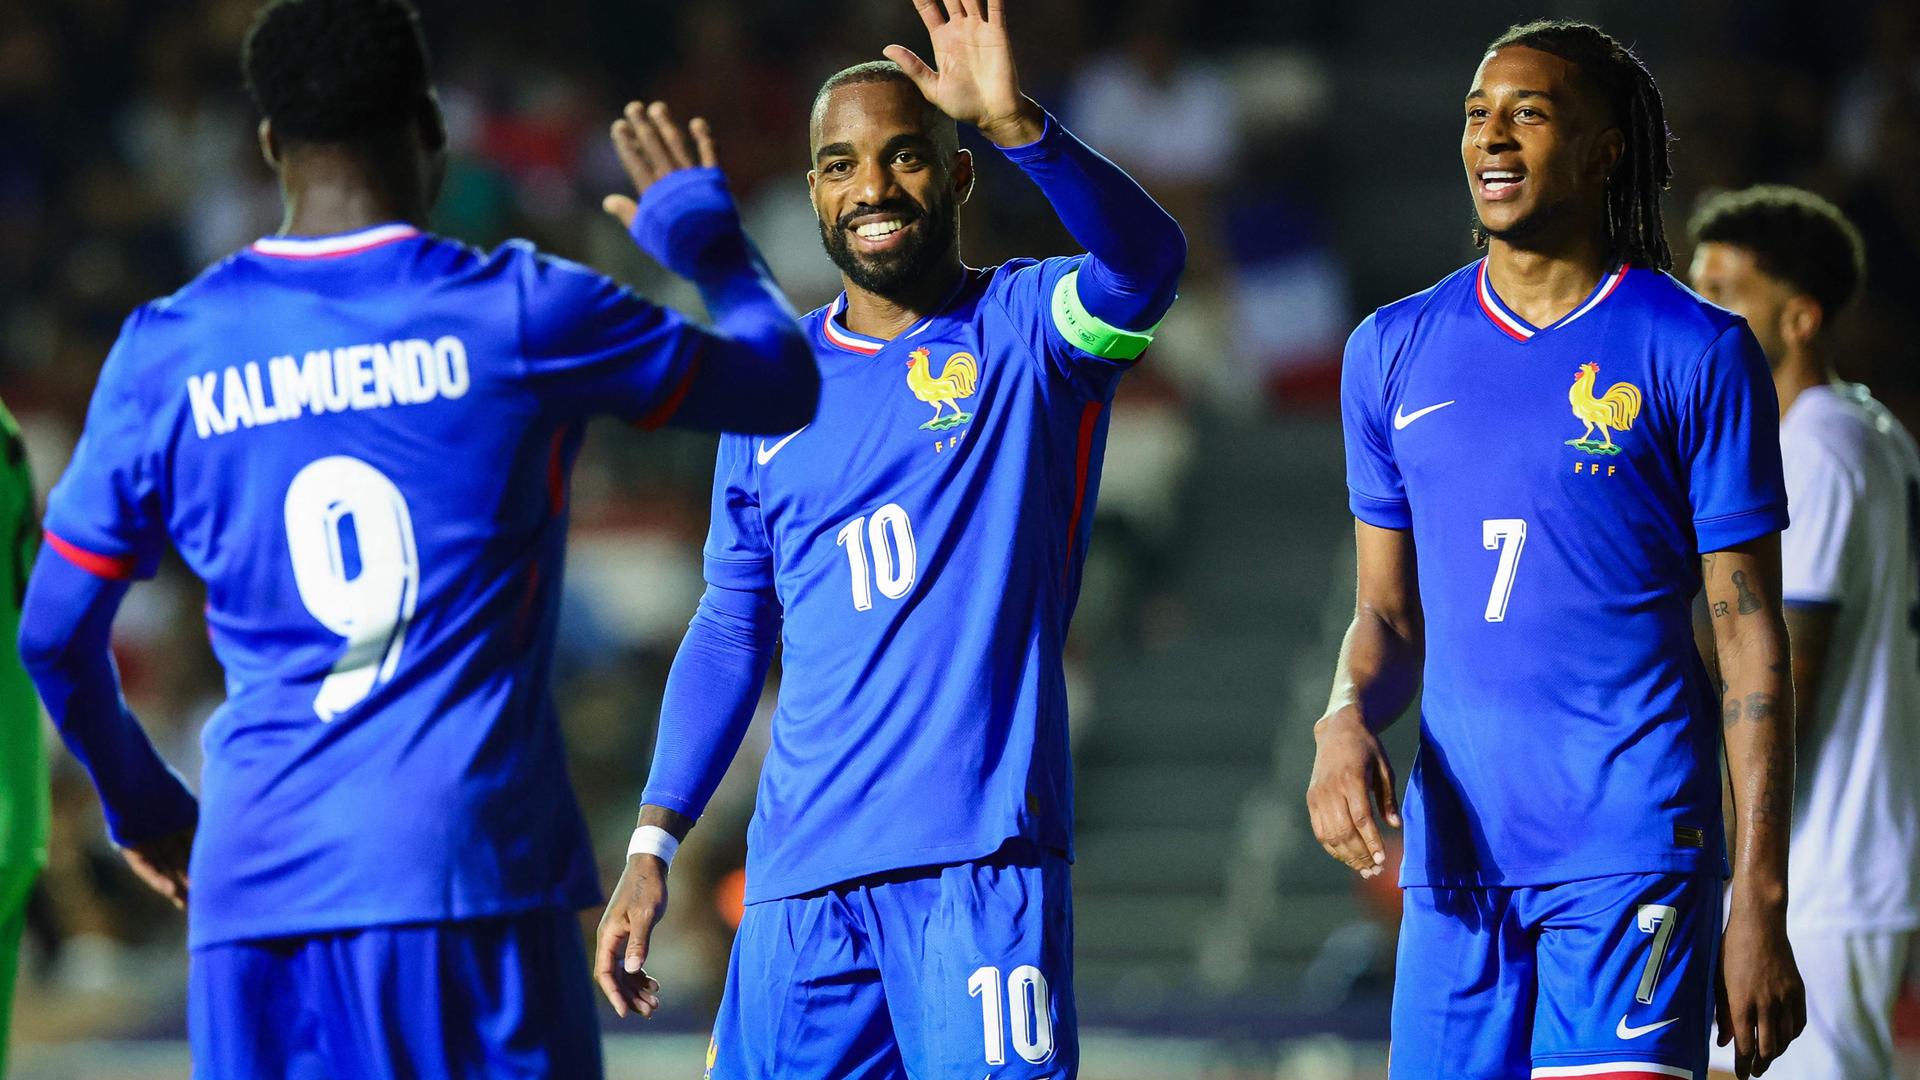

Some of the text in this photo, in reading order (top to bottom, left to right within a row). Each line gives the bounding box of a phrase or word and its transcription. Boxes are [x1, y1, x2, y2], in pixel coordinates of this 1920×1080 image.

[186, 335, 470, 439] KALIMUENDO
[284, 455, 420, 724] 9
[836, 503, 917, 612] 10
[1482, 518, 1528, 623] 7
[1635, 903, 1677, 1005] 7
[967, 964, 1055, 1066] 10
